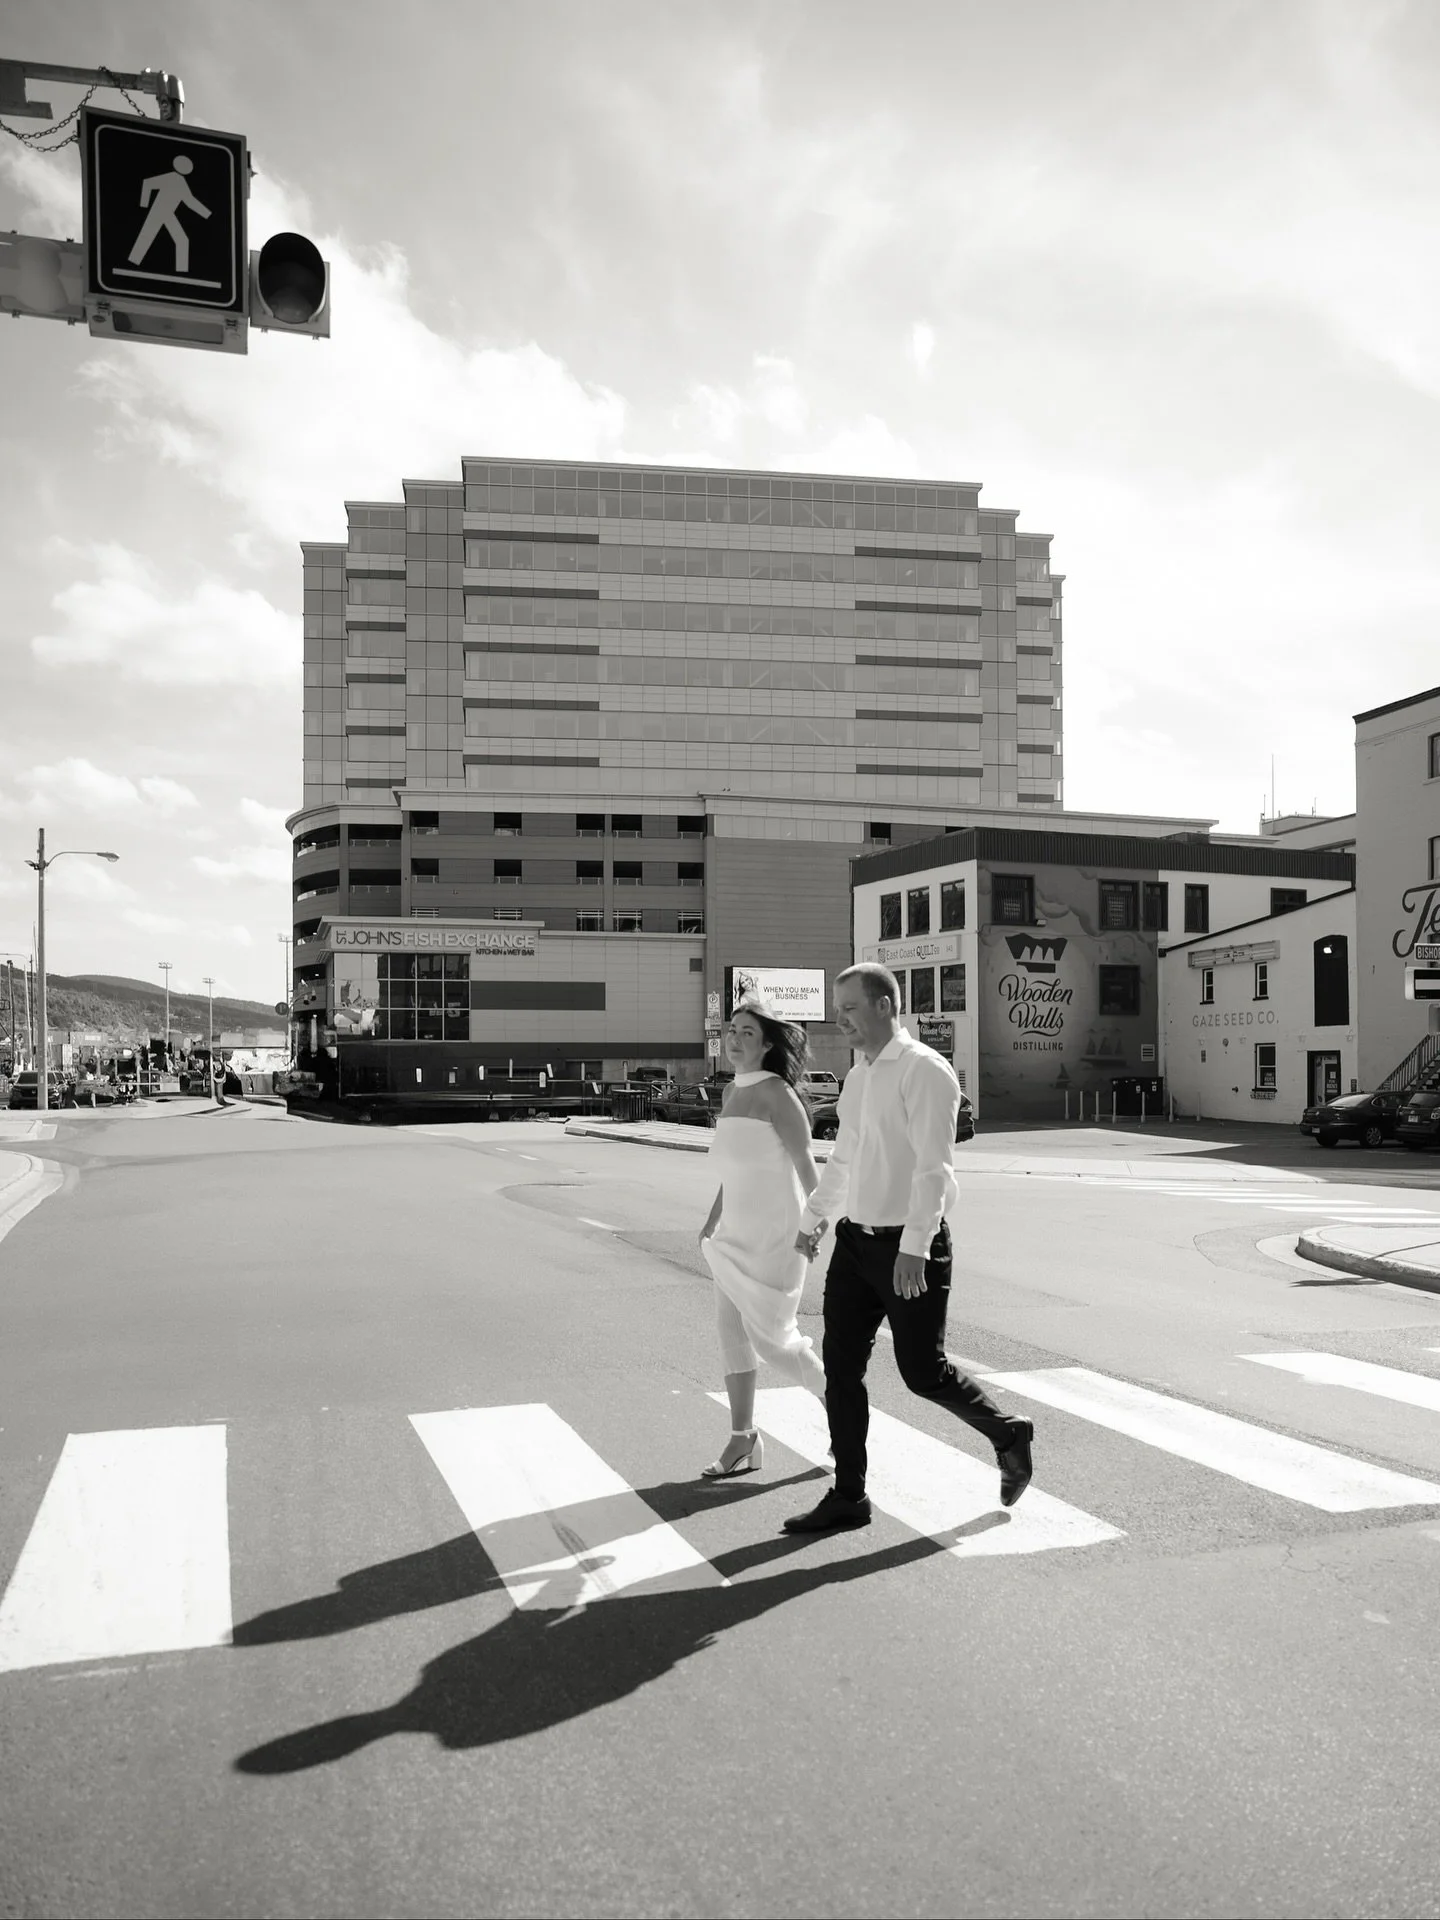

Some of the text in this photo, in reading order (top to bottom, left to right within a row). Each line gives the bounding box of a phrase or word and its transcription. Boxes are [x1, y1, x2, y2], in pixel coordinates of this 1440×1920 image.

[348, 931, 402, 945] JOHN'S
[403, 932, 443, 947] FISH
[445, 933, 535, 949] EXCHANGE
[886, 950, 899, 961] East
[900, 947, 916, 959] Coast
[999, 974, 1073, 1005] Wooden
[1008, 1002, 1064, 1037] Walls
[1192, 1014, 1221, 1028] GAZE
[1223, 1012, 1254, 1026] SEED
[1013, 1041, 1064, 1051] DISTILLING
